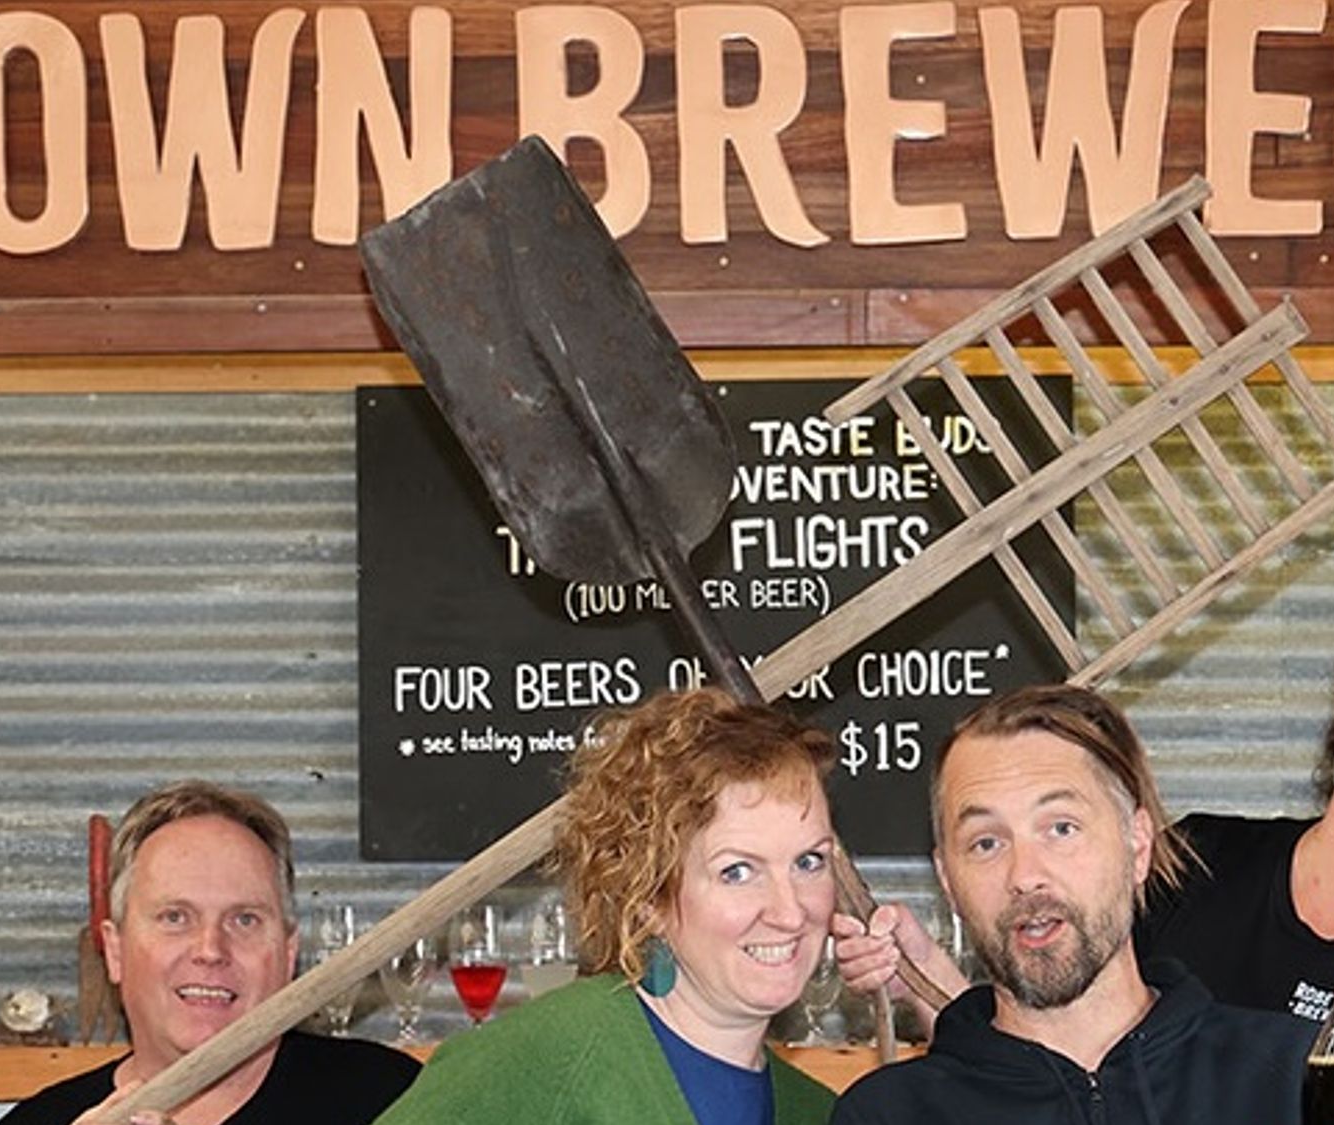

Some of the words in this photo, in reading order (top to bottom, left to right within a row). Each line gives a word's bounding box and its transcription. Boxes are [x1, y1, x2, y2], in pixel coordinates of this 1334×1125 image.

[749, 416, 875, 457] TASTE
[730, 463, 938, 503] VENTURE:
[730, 514, 930, 572] FLIGHTS
[565, 582, 625, 622] (100
[701, 579, 739, 609] ER
[750, 576, 831, 615] BEER)
[394, 665, 493, 712] FOUR
[516, 657, 641, 710] BEERS
[422, 735, 456, 753] see
[460, 726, 521, 765] tasting
[528, 729, 576, 753] notes
[840, 720, 922, 776] $15
